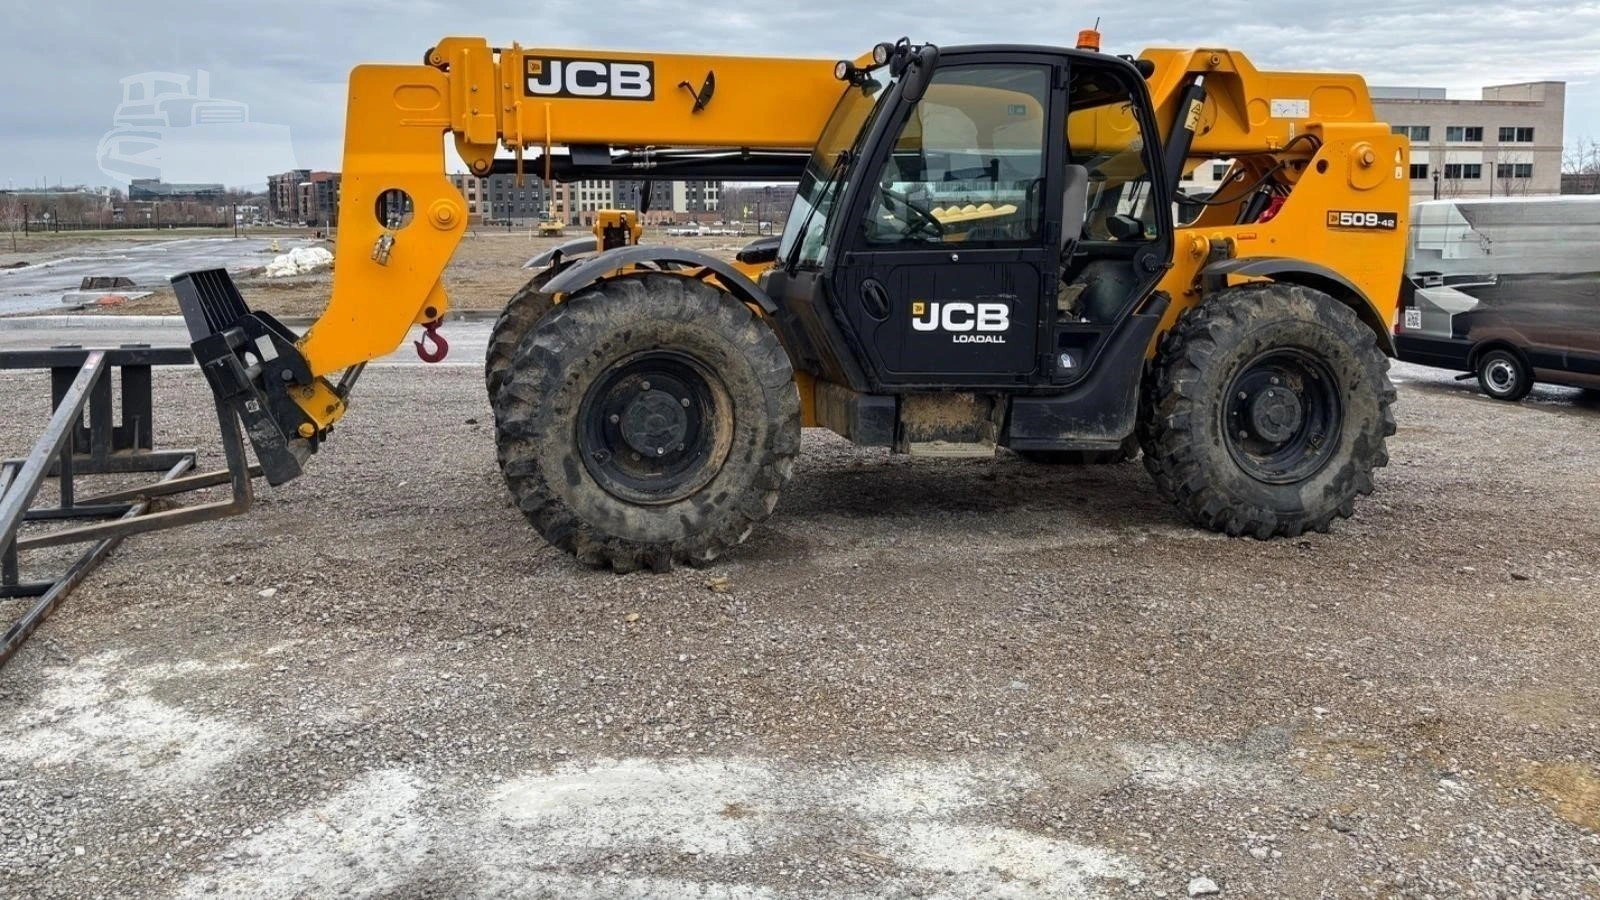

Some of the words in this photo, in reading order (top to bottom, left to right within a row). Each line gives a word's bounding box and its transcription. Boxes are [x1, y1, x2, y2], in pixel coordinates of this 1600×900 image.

[528, 60, 652, 97] JCB
[1340, 212, 1395, 227] 509-42
[912, 302, 1009, 331] JCB
[952, 335, 1006, 344] LOADALL
